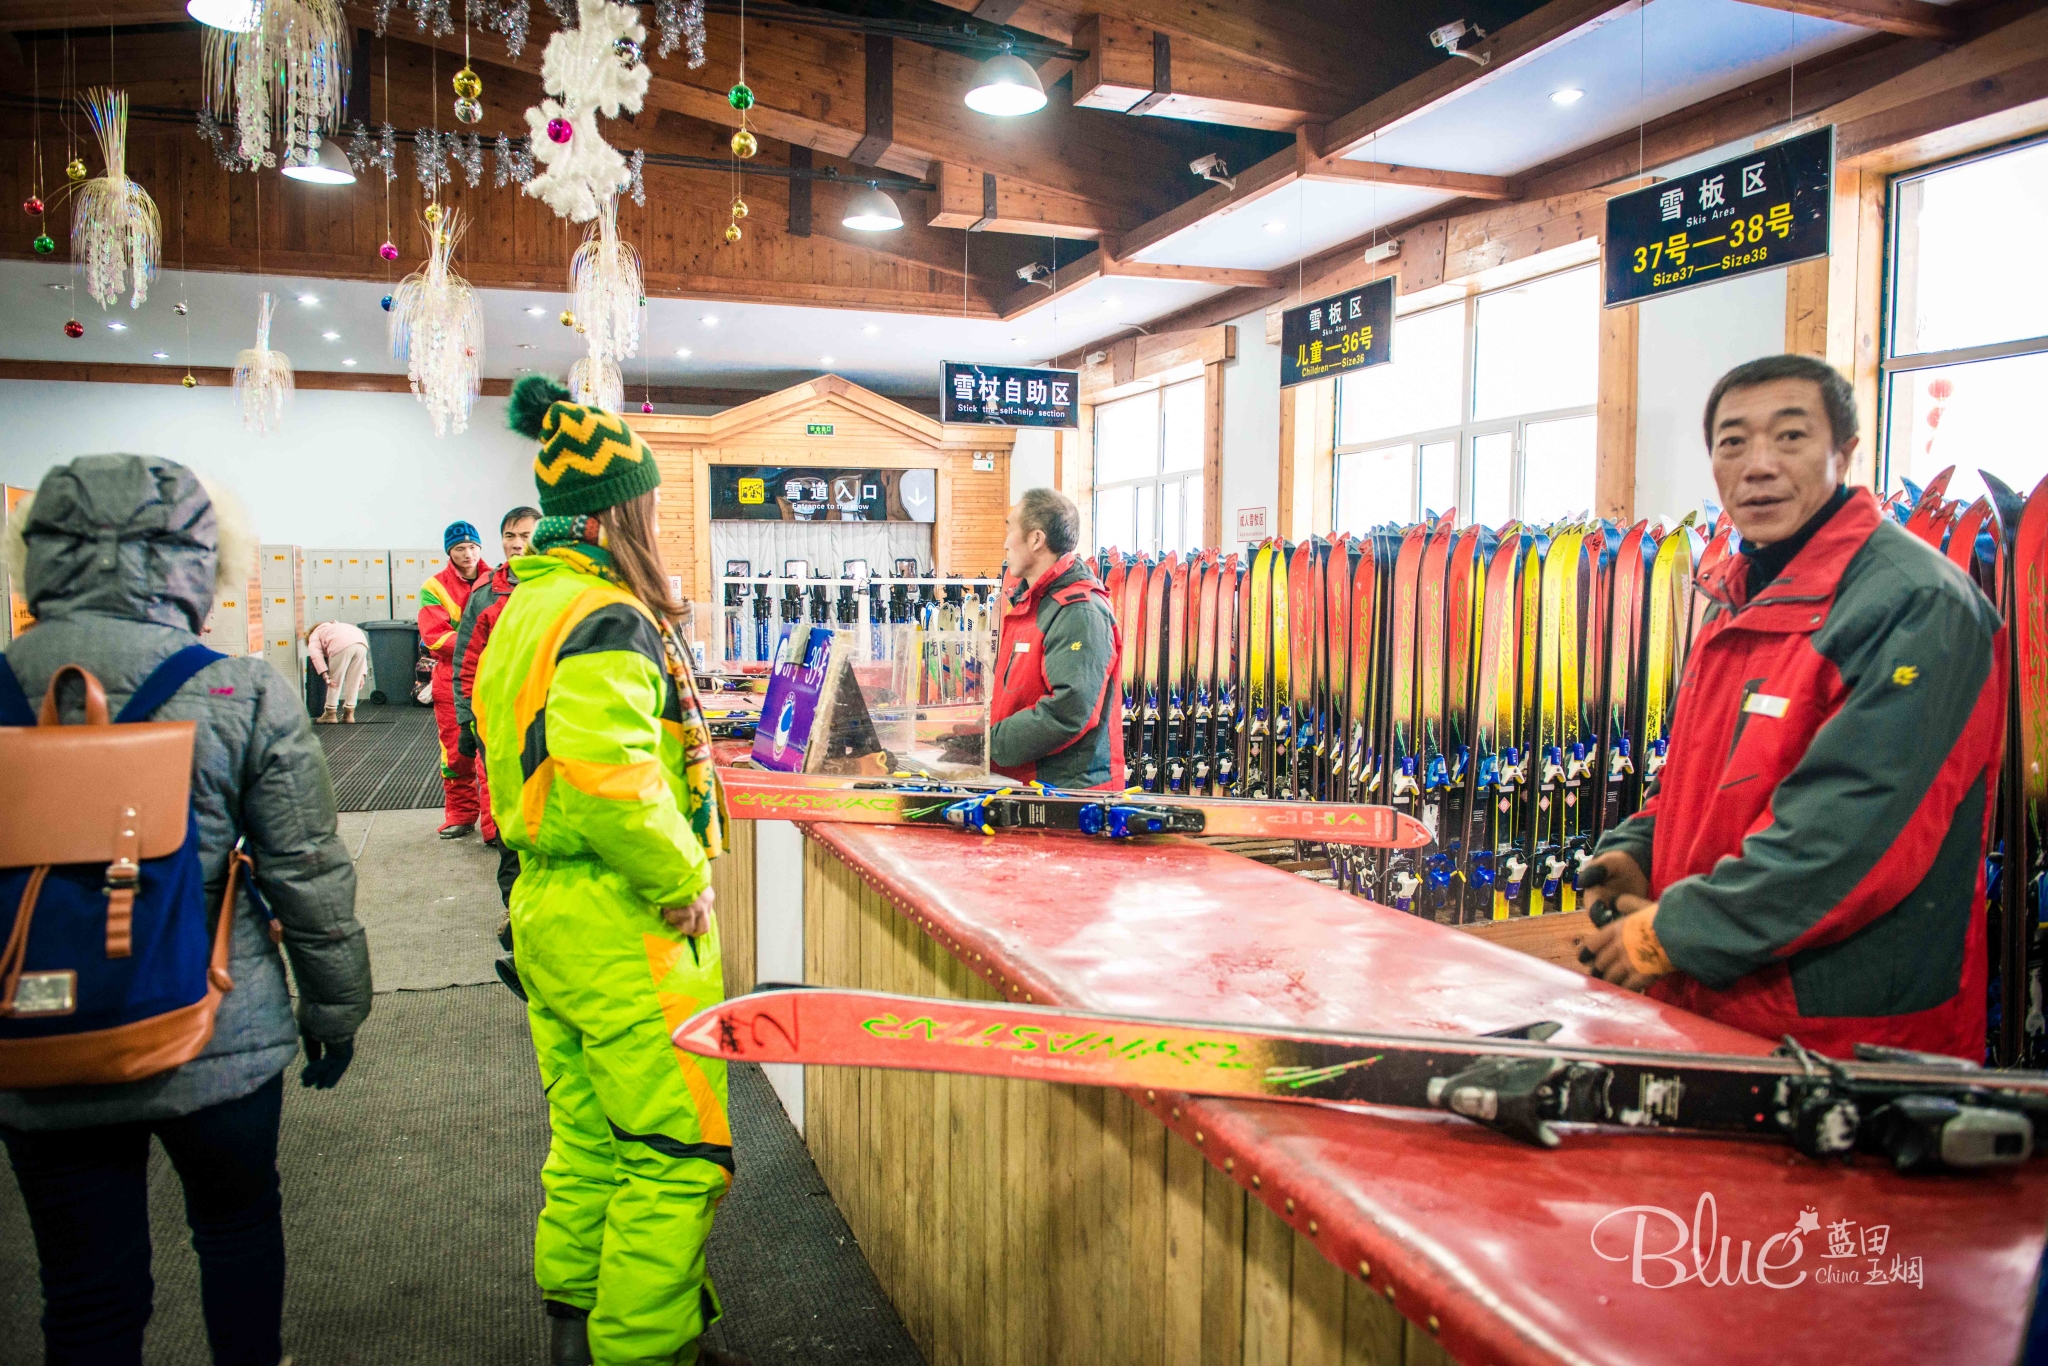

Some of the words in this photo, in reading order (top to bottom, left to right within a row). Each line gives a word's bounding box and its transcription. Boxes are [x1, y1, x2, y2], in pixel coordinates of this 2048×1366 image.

[1660, 161, 1767, 222] 雪板区
[1686, 215, 1707, 228] Skis
[1711, 206, 1736, 221] Area
[1309, 296, 1362, 332] 雪板区
[953, 373, 1071, 407] 雪杖自助区
[958, 403, 978, 413] Stick
[982, 405, 995, 414] the
[1000, 406, 1034, 418] self-help
[1038, 409, 1066, 419] section
[784, 481, 878, 501] 雪道入口
[792, 503, 825, 511] Entrance
[1400, 582, 1412, 717] DYNASTAR
[1431, 581, 1440, 714] DYNASTAR
[1617, 573, 1629, 700] DYNASTAR
[733, 792, 898, 812] DYNASTAR
[861, 1013, 1255, 1070] DYNASTAR
